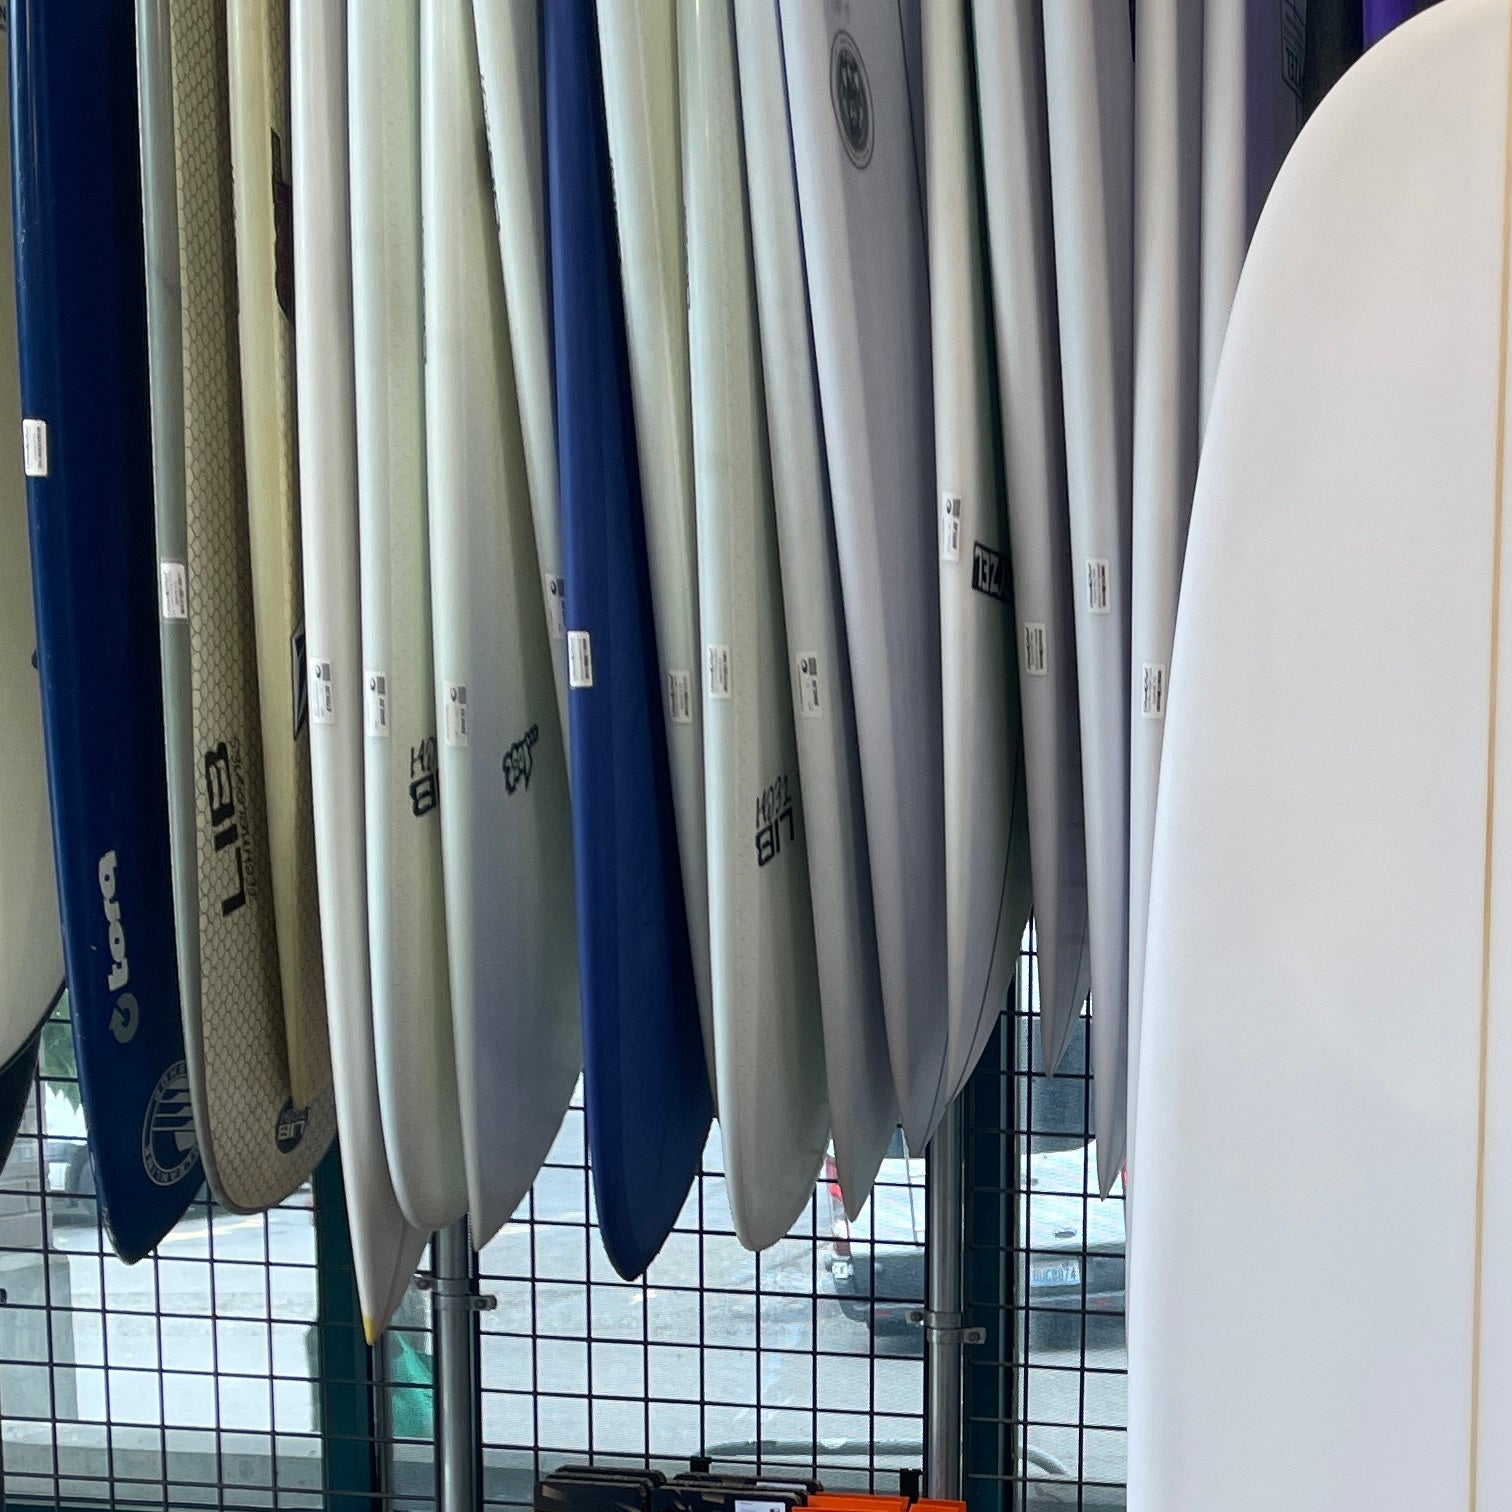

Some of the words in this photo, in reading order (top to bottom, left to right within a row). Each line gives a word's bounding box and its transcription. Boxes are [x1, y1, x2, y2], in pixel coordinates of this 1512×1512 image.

[205, 742, 246, 917] LIB
[755, 806, 795, 867] LIB
[98, 849, 129, 992] torq
